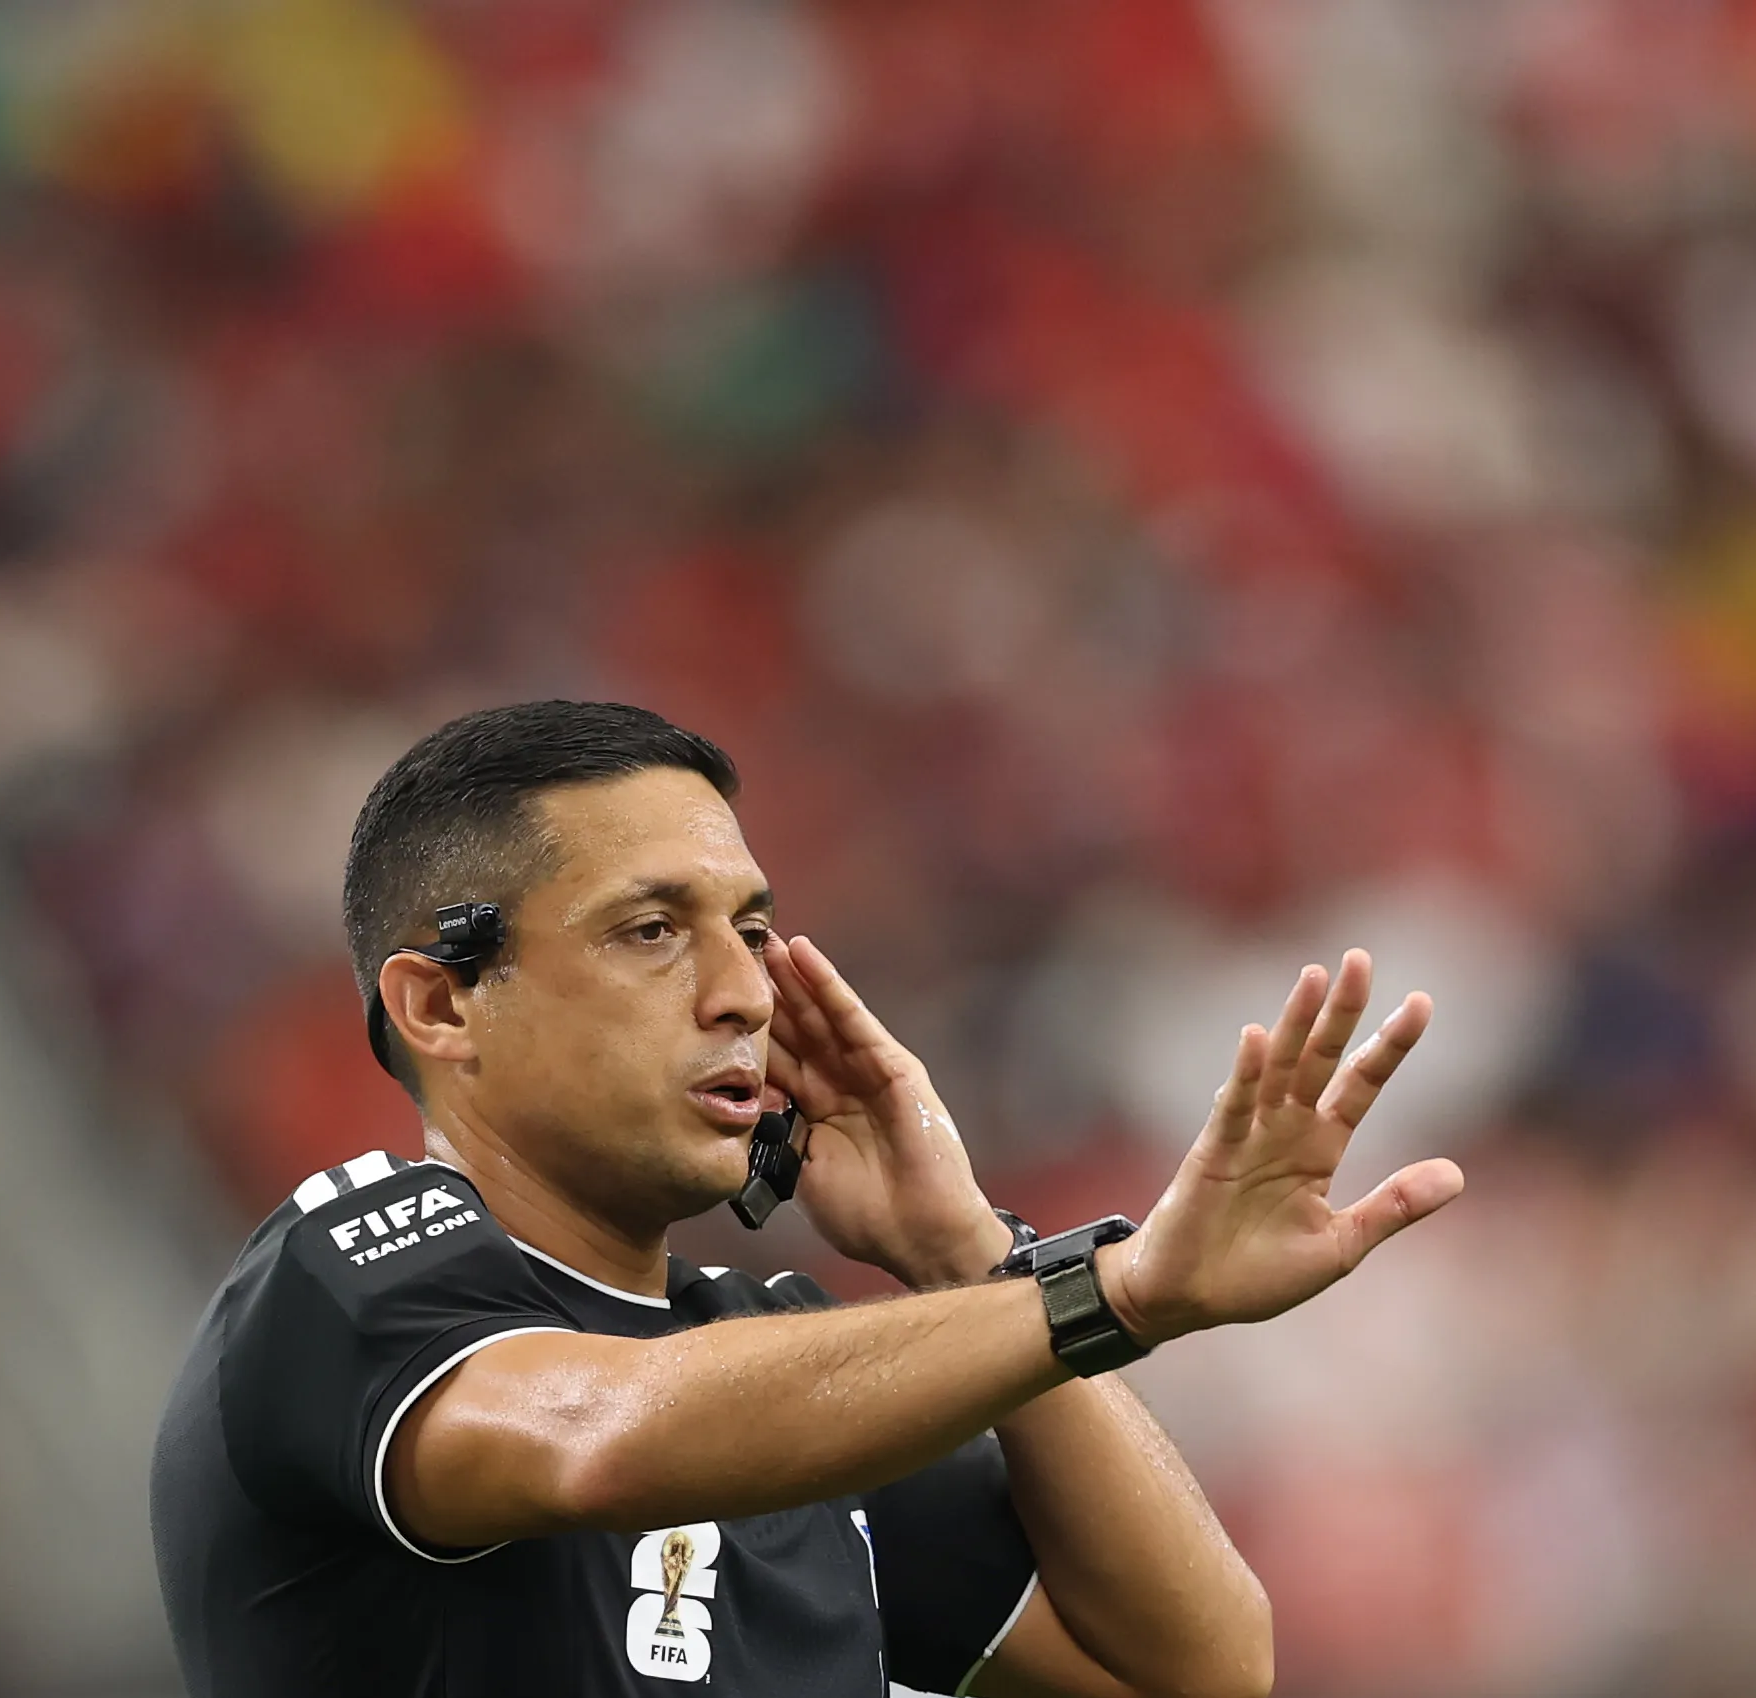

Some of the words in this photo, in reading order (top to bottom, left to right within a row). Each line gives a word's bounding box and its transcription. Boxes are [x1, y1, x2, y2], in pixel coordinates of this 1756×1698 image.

[438, 916, 467, 931] Lenovo
[329, 1187, 464, 1251] FIFA
[349, 1231, 421, 1266] TEAM
[425, 1210, 481, 1237] ONE
[650, 1644, 688, 1665] FIFA
